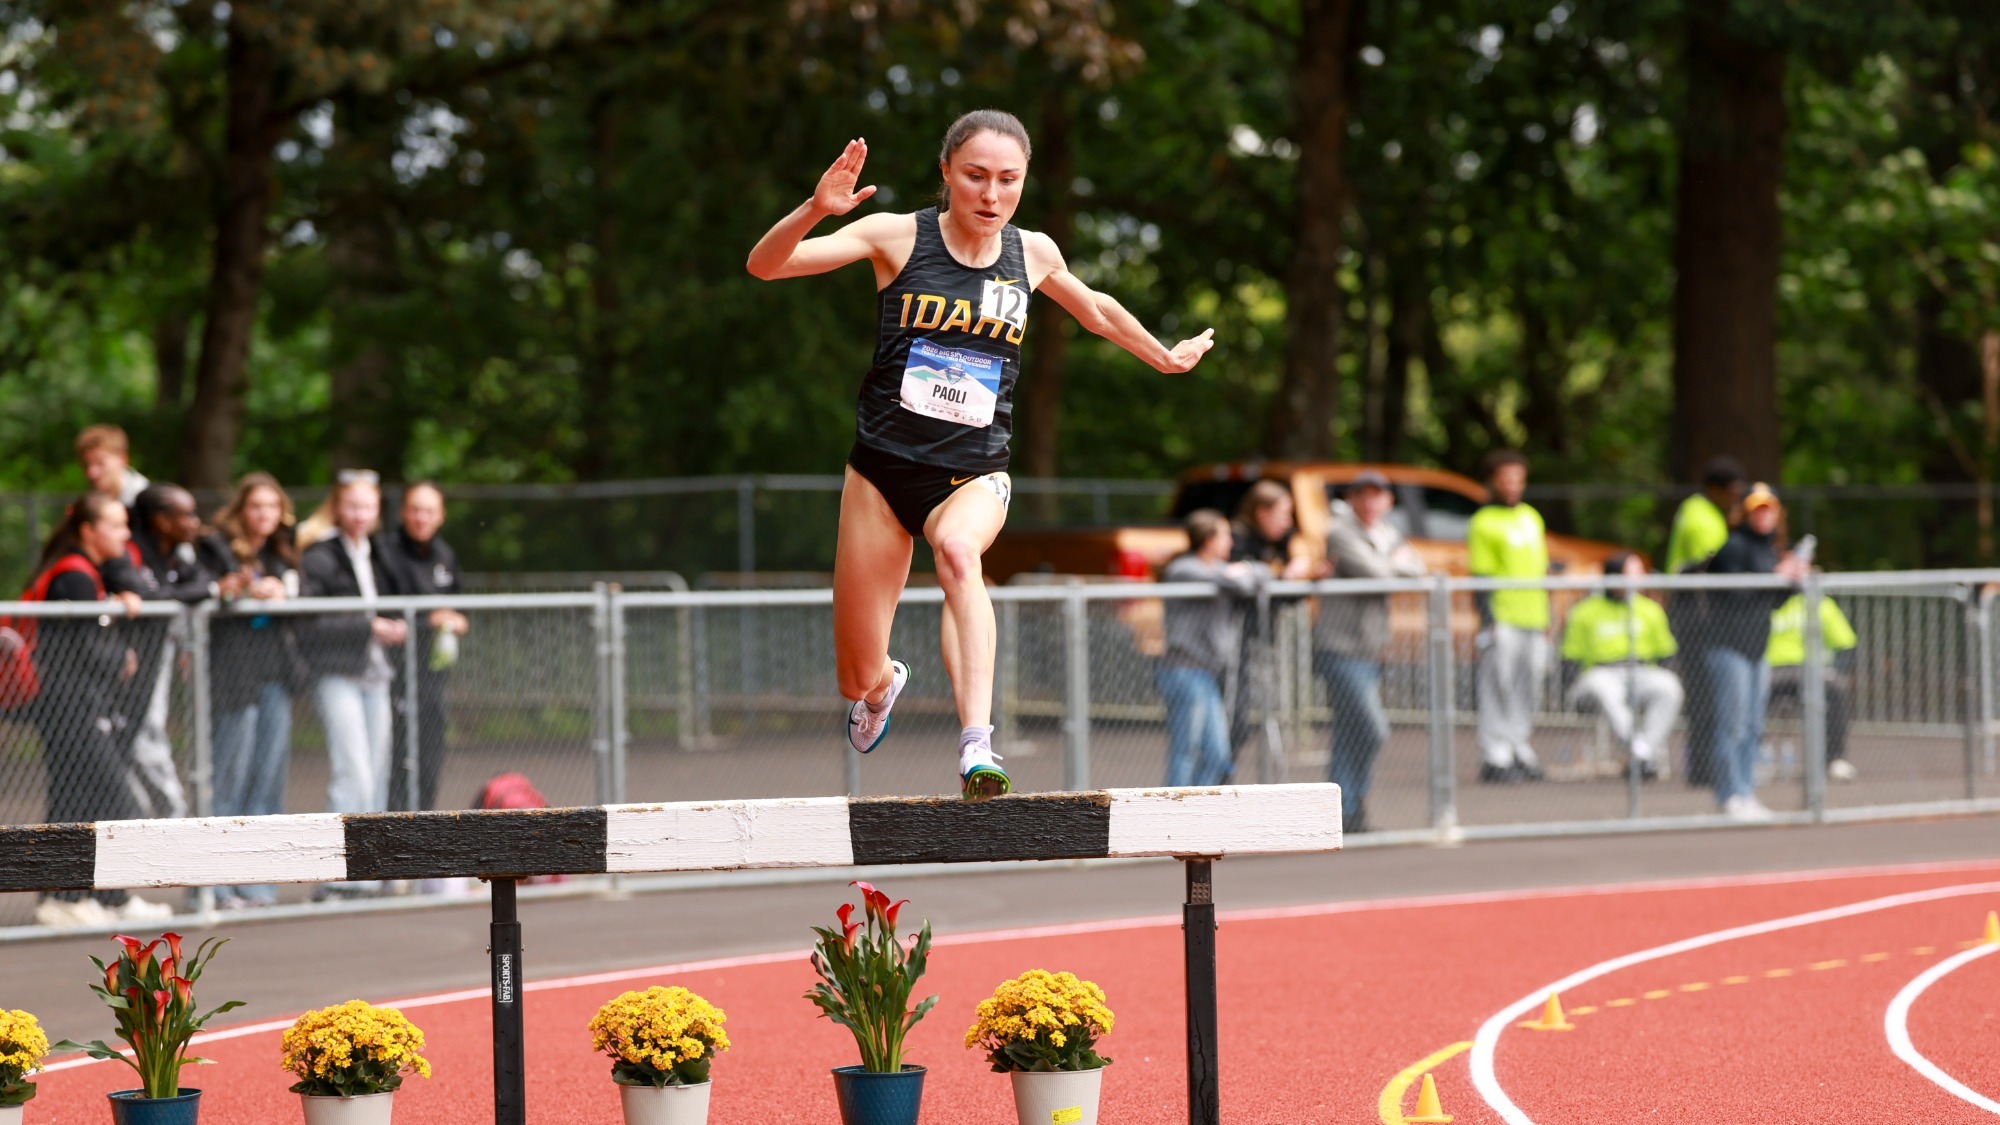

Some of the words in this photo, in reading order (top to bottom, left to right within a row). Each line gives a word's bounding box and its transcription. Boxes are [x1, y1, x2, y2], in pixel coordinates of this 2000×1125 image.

[992, 285, 1021, 325] 12
[950, 351, 963, 359] SKY
[963, 355, 992, 364] OUTDOOR
[932, 384, 967, 404] PAOLI
[502, 956, 511, 1001] SPORTS-FAB
